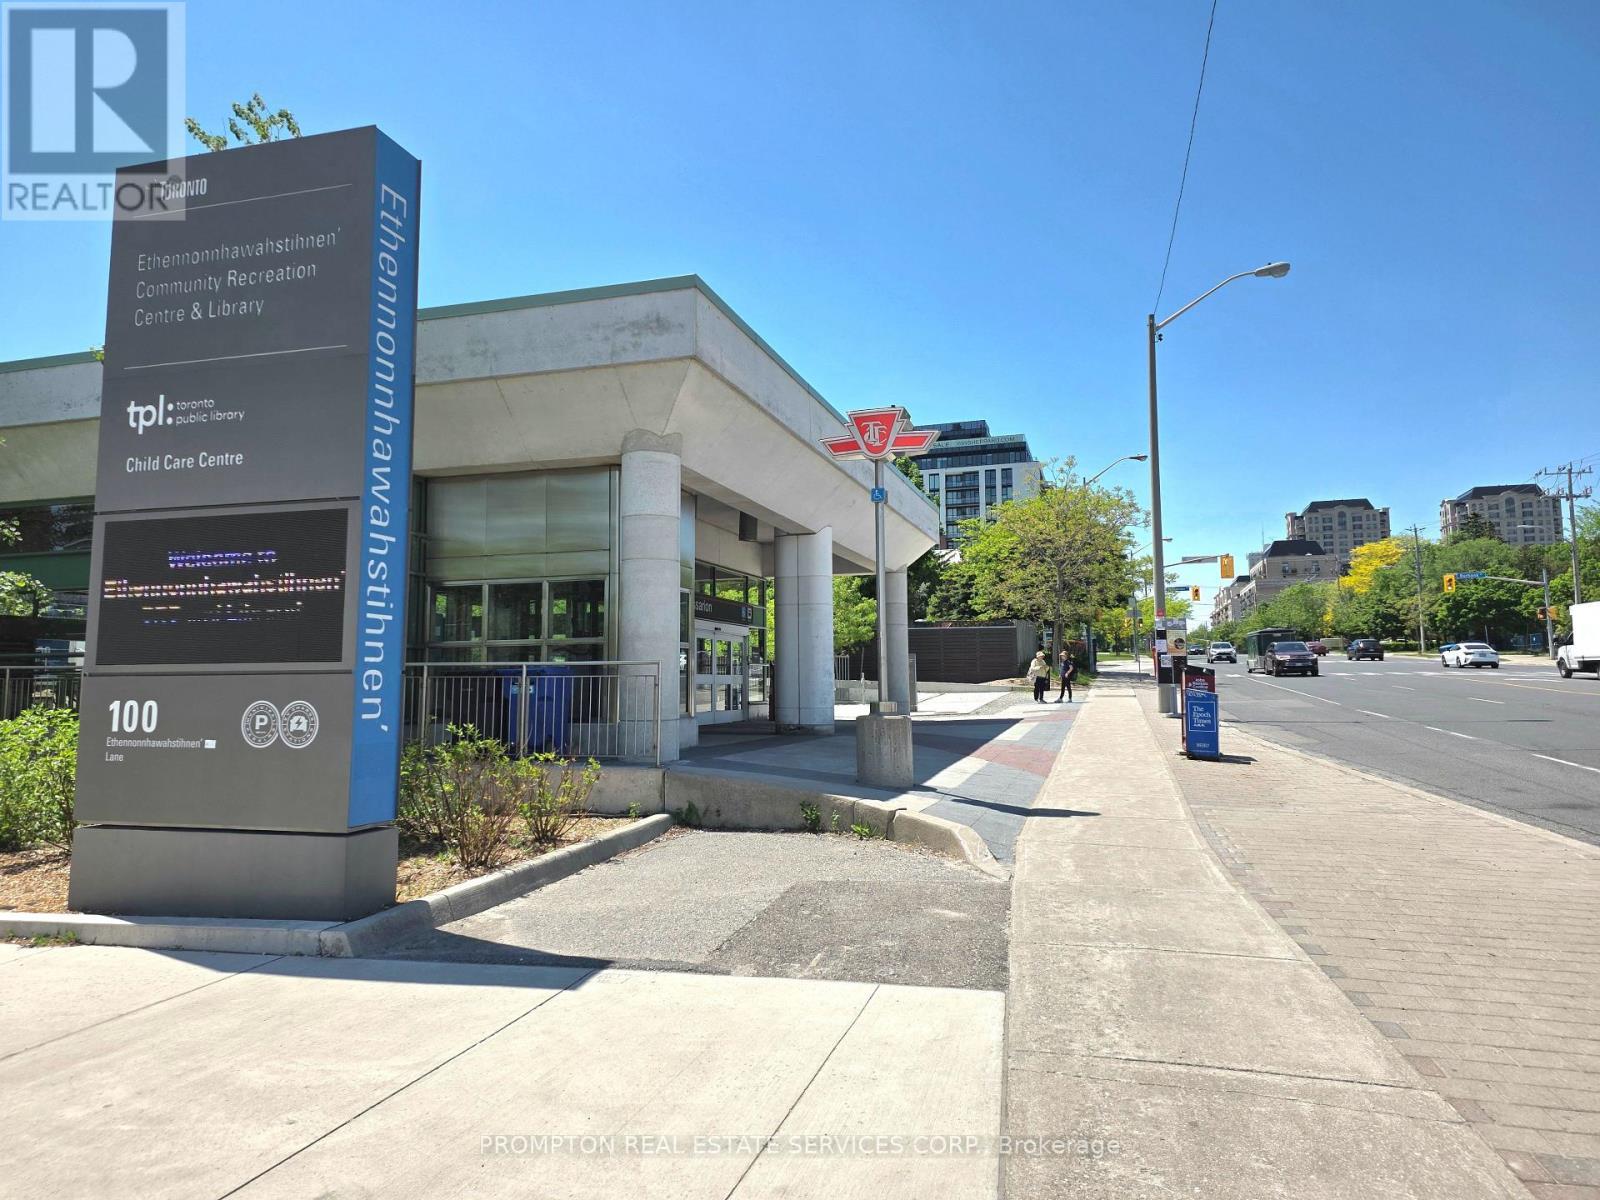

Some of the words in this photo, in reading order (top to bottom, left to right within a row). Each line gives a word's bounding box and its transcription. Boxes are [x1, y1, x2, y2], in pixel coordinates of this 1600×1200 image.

[160, 178, 208, 201] TORONTO
[136, 275, 222, 299] Community
[227, 262, 317, 288] Recreation
[134, 308, 186, 327] Centre
[190, 302, 203, 321] &
[208, 299, 265, 319] Library
[176, 399, 215, 411] toronto
[175, 412, 209, 426] public
[210, 410, 246, 422] library
[126, 456, 160, 473] Child
[163, 454, 195, 470] Care
[198, 451, 244, 468] Centre
[694, 600, 713, 613] sarion
[109, 700, 158, 733] 100
[105, 752, 124, 762] Lane
